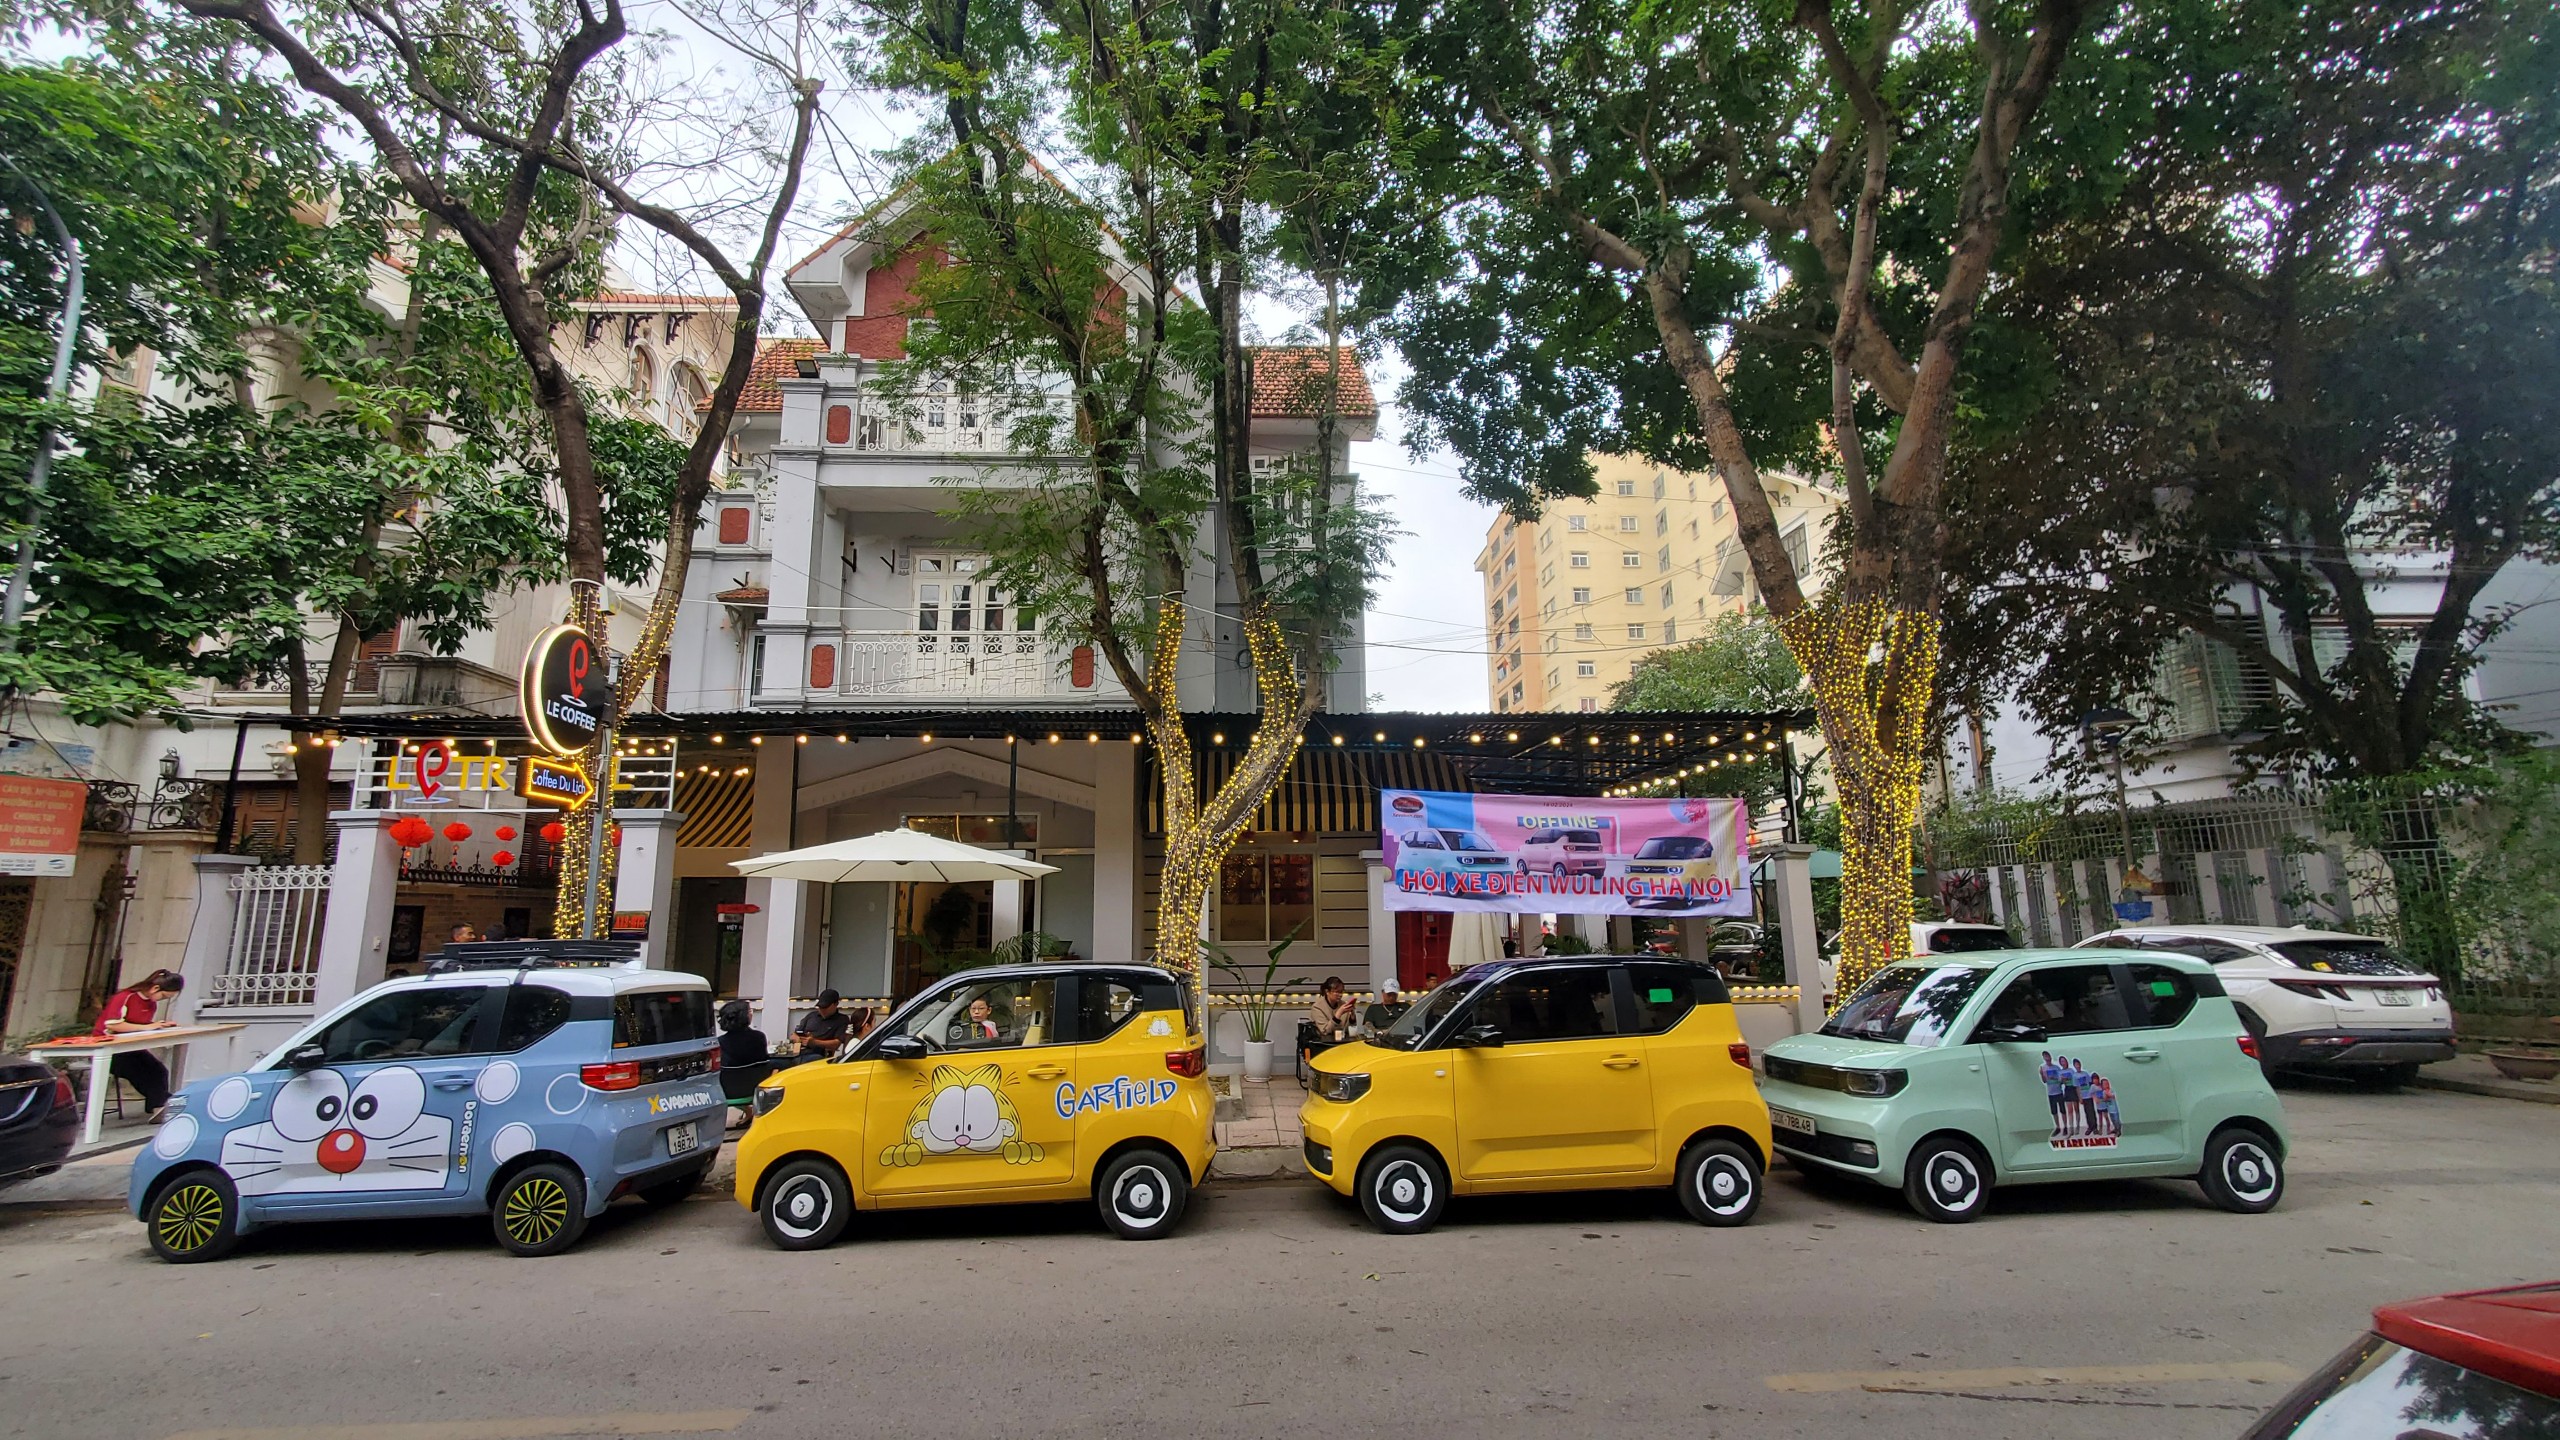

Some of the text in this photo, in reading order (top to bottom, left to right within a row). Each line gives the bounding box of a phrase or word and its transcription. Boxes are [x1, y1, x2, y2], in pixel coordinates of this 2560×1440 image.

[546, 699, 596, 732] LE COFFEE
[532, 768, 557, 788] Coffee
[558, 776, 571, 791] Du
[1522, 815, 1599, 830] OFFLINE
[1403, 867, 1733, 903] HỘI XE ĐIỆN WULING HÀ NỘI
[457, 1100, 478, 1174] Doraemon
[675, 1126, 690, 1139] 30L
[2050, 1136, 2117, 1149] WE ARE FAMILY
[673, 1137, 696, 1154] 198.21
